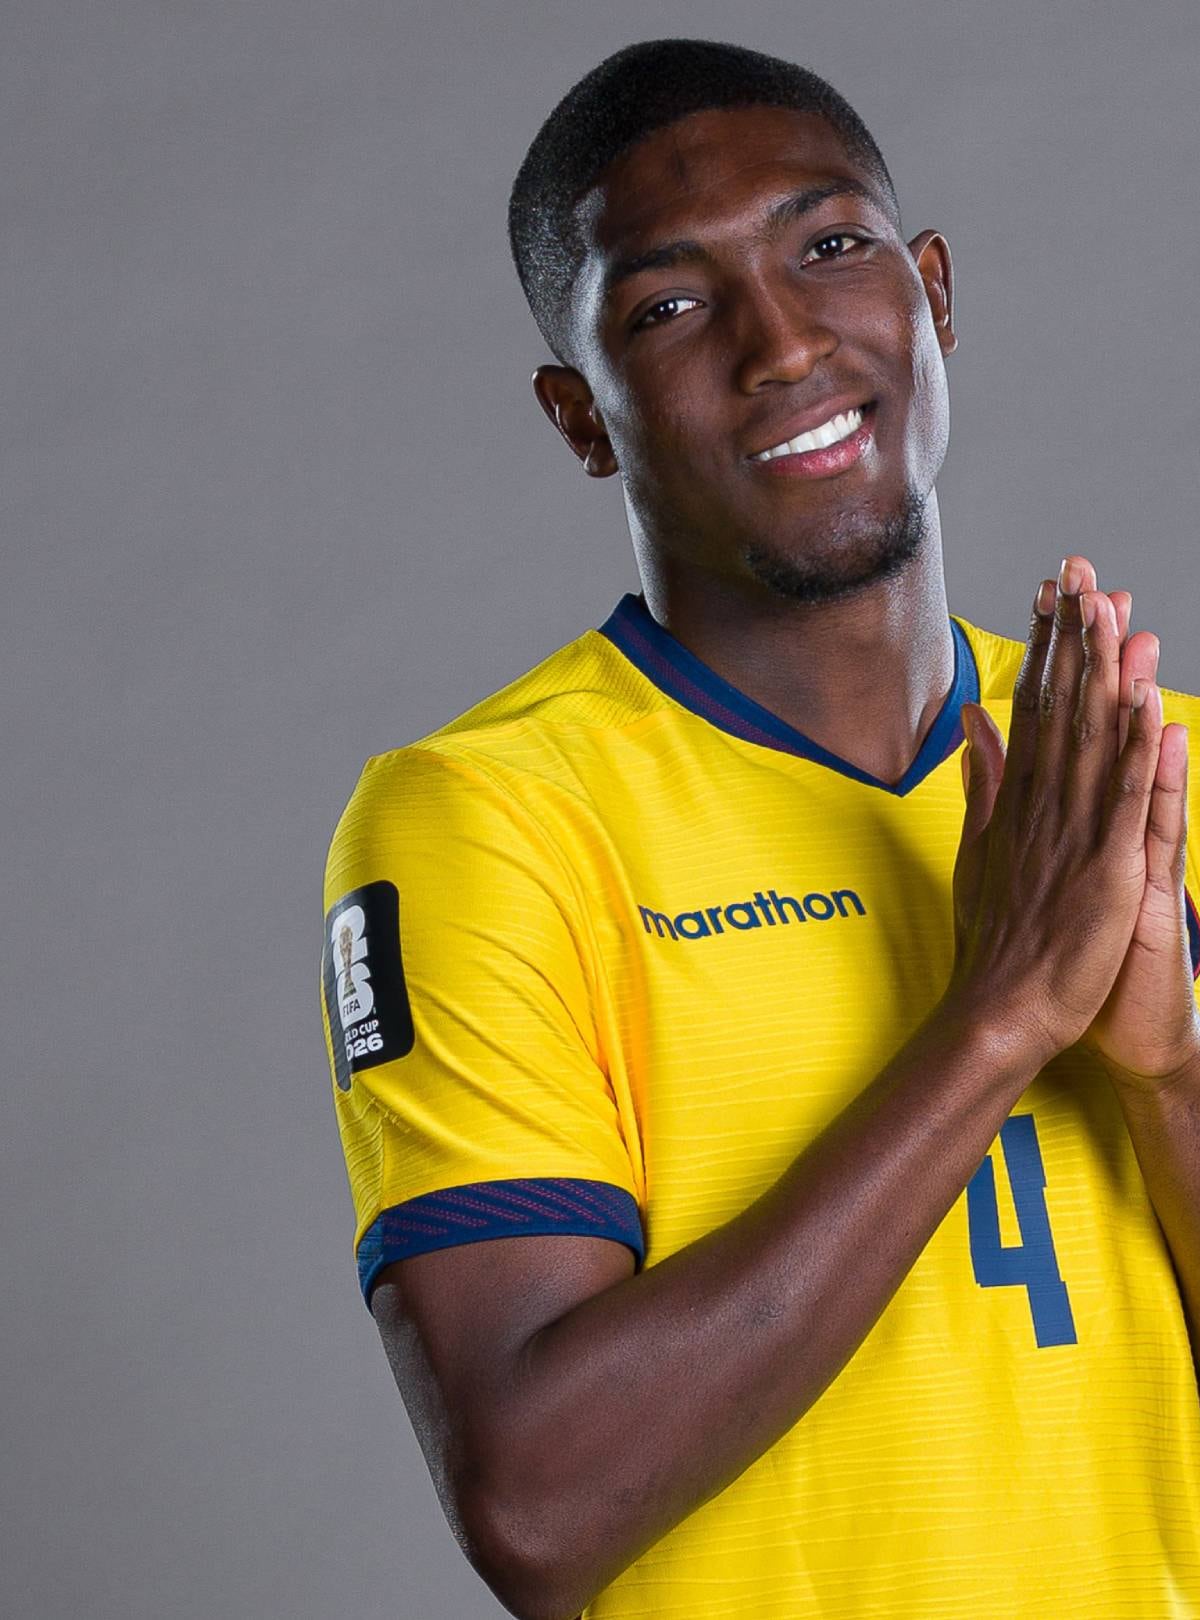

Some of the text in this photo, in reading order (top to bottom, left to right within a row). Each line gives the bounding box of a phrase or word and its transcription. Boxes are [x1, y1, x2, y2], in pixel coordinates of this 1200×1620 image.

[637, 889, 867, 941] marathon
[342, 998, 361, 1017] FIFA
[359, 1019, 379, 1035] CUP
[345, 1033, 384, 1062] 026
[966, 1113, 1078, 1348] 4
